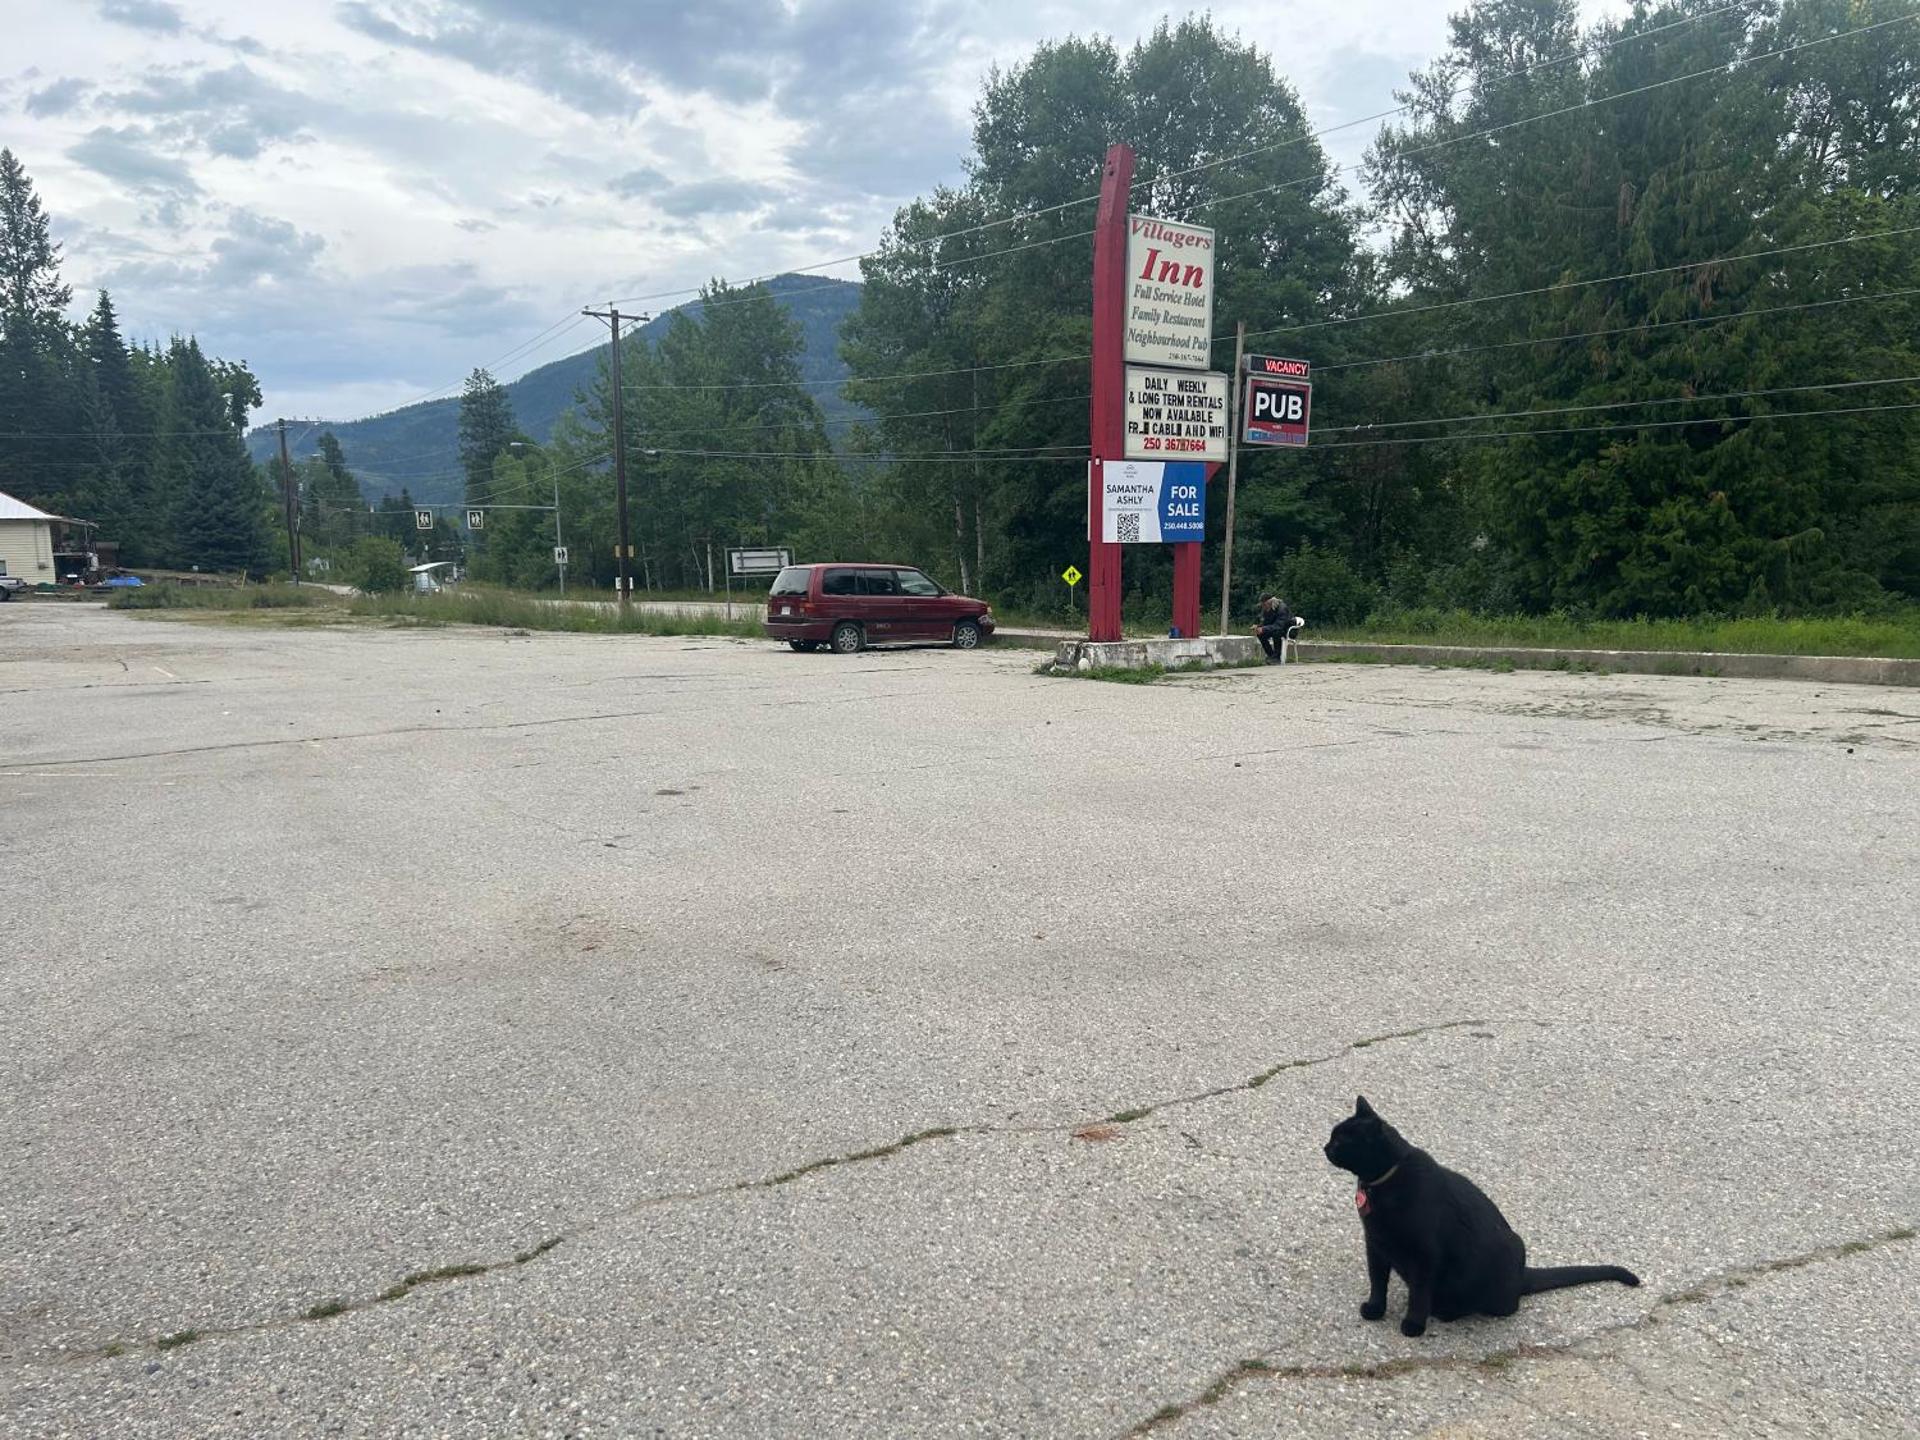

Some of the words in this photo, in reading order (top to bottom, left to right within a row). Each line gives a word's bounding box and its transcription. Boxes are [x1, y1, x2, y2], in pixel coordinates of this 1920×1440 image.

[1132, 219, 1212, 250] Villagers
[1139, 248, 1204, 289] Inn
[1134, 284, 1153, 300] Full
[1153, 287, 1183, 305] Service
[1183, 292, 1206, 308] Hotel
[1131, 306, 1161, 326] Family
[1162, 310, 1206, 329] Restaurant
[1128, 328, 1191, 349] Neighbourhood
[1191, 336, 1208, 351] Pub
[1265, 359, 1307, 375] VACANCY
[1145, 377, 1168, 391] DAILY
[1177, 380, 1207, 393] WEEKLY
[1128, 391, 1135, 404] &
[1138, 392, 1160, 405] LONG
[1162, 393, 1185, 407] TERM
[1186, 396, 1223, 409] RENTALS
[1255, 391, 1303, 420] PUB
[1142, 407, 1162, 420] NOW
[1167, 408, 1214, 423] AVAILABLE
[1185, 424, 1206, 437] AND
[1209, 425, 1225, 438] WIFI
[1143, 437, 1161, 450] 250
[1106, 484, 1154, 494] SAMANTHA
[1171, 485, 1197, 499] FOR
[1117, 496, 1143, 505] ASHLY
[1167, 503, 1199, 517] SALE
